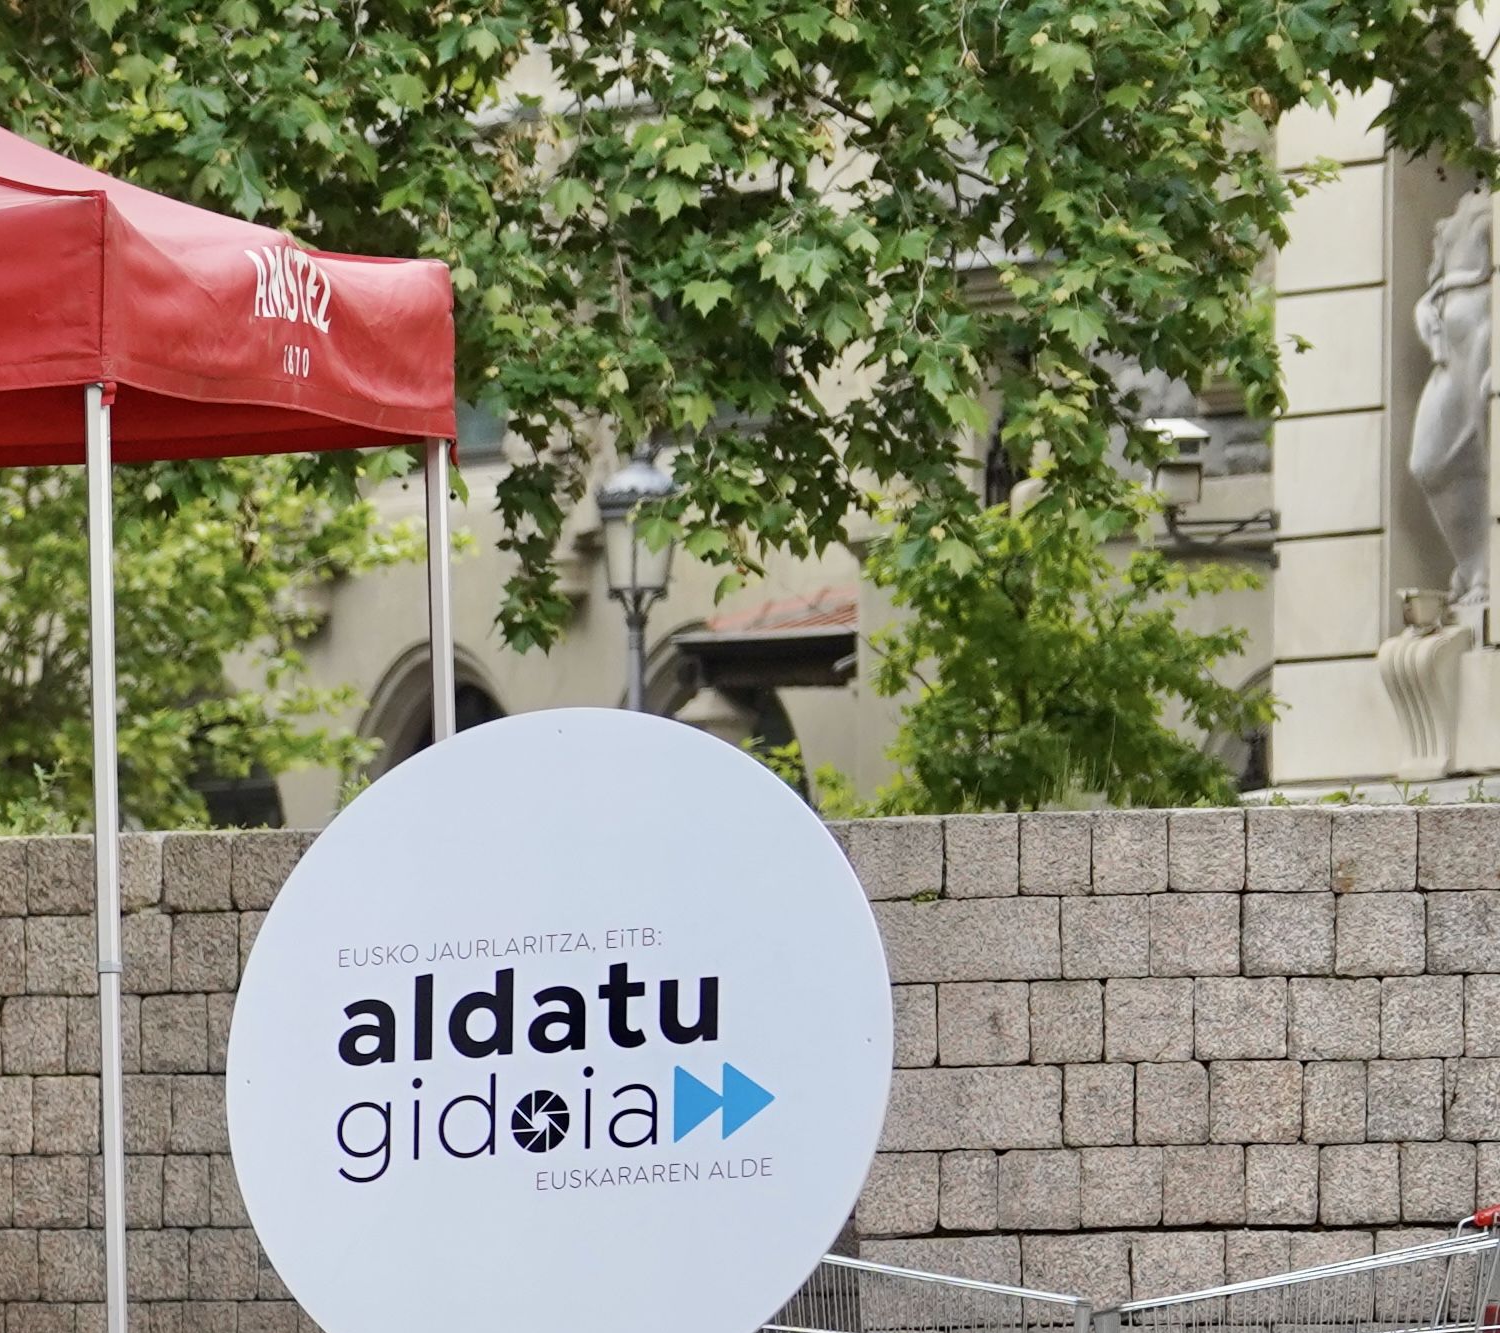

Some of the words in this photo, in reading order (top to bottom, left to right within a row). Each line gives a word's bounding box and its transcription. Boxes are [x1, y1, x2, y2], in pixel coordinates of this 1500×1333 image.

[244, 246, 331, 334] AMSTEL
[283, 344, 310, 378] 1870
[338, 943, 419, 968] EUSKO
[425, 932, 597, 962] JAURLARITZA,
[606, 927, 662, 950] EiTB:
[338, 962, 719, 1066] aldatu
[337, 1067, 658, 1183] gidoia
[535, 1162, 700, 1191] EUSKARAREN
[708, 1157, 773, 1180] ALDE
